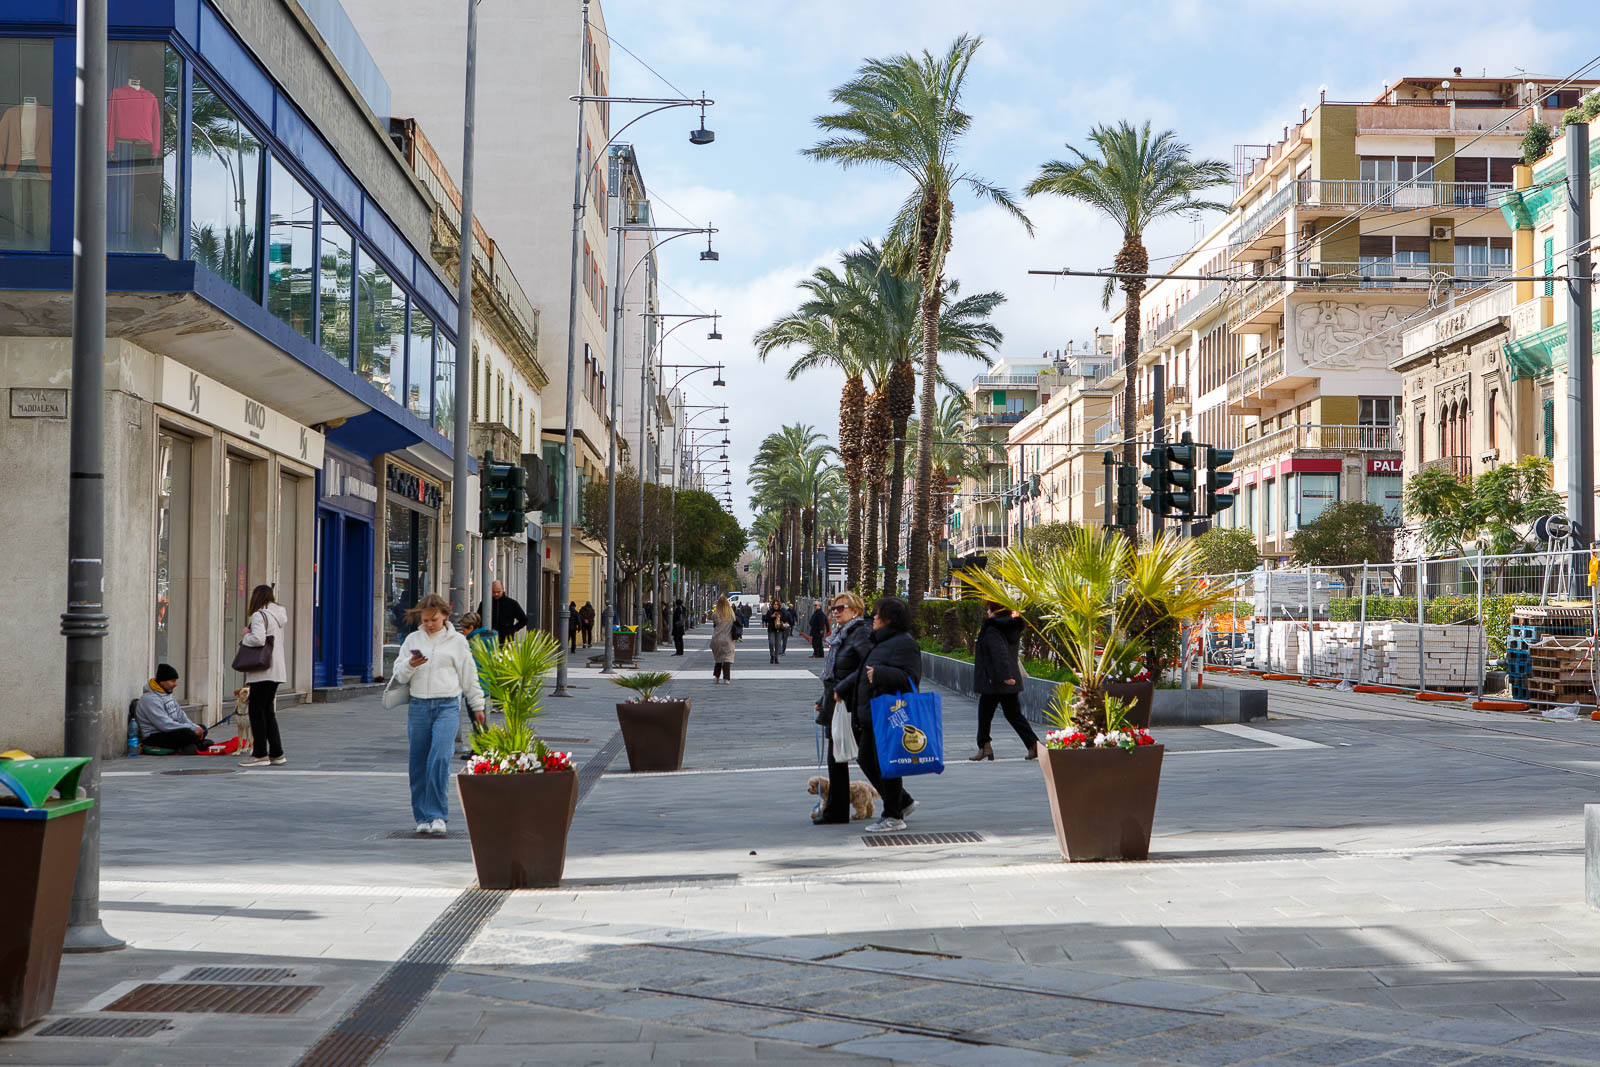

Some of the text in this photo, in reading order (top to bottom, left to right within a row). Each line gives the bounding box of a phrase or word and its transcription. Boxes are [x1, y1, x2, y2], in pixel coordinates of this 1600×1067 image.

[31, 393, 47, 402] VIA
[18, 404, 59, 413] MADDALENA
[245, 399, 266, 430] KIKO
